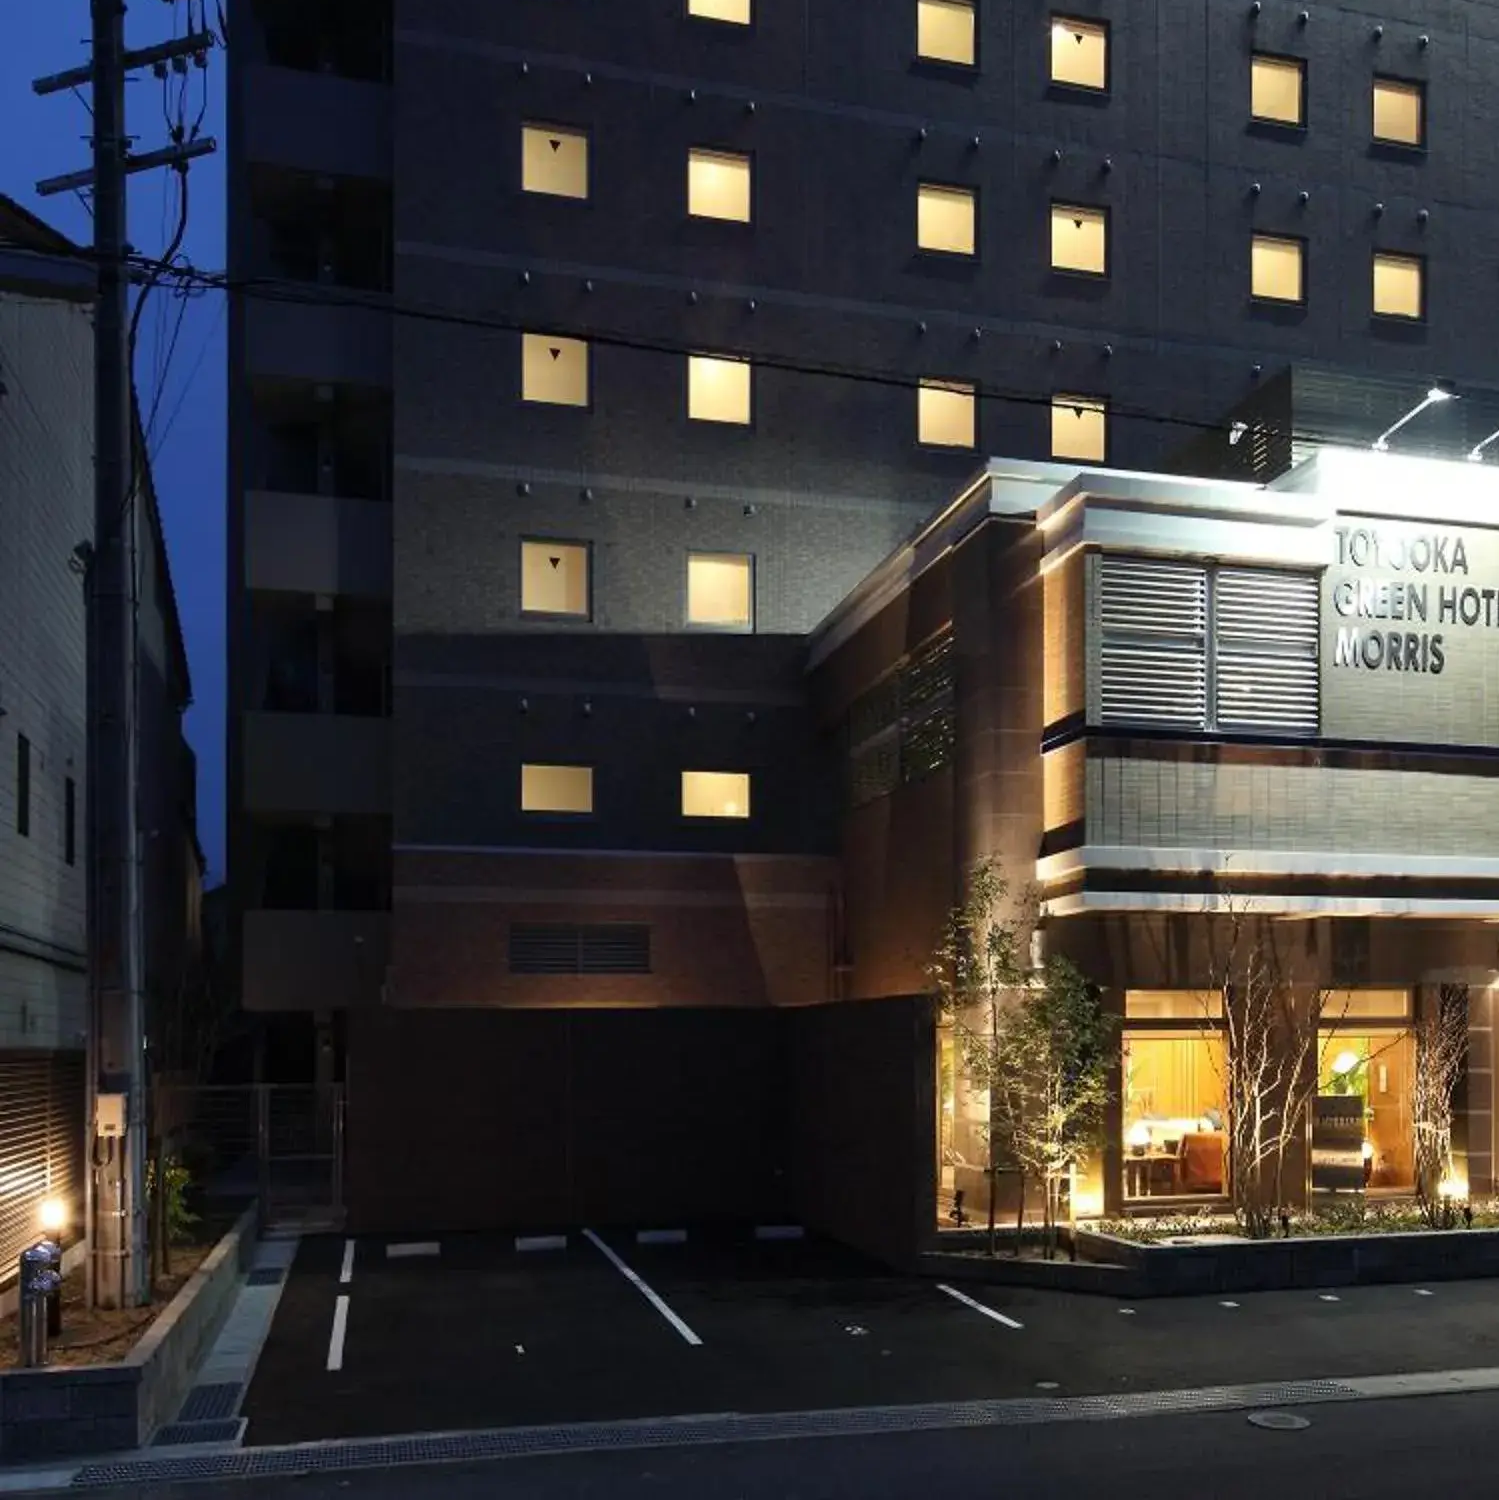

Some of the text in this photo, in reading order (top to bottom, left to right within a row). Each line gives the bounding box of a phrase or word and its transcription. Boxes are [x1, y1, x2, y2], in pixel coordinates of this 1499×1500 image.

[1334, 526, 1468, 575] TOYOOKA
[1334, 578, 1427, 622] GREEN
[1333, 627, 1445, 674] MORRIS
